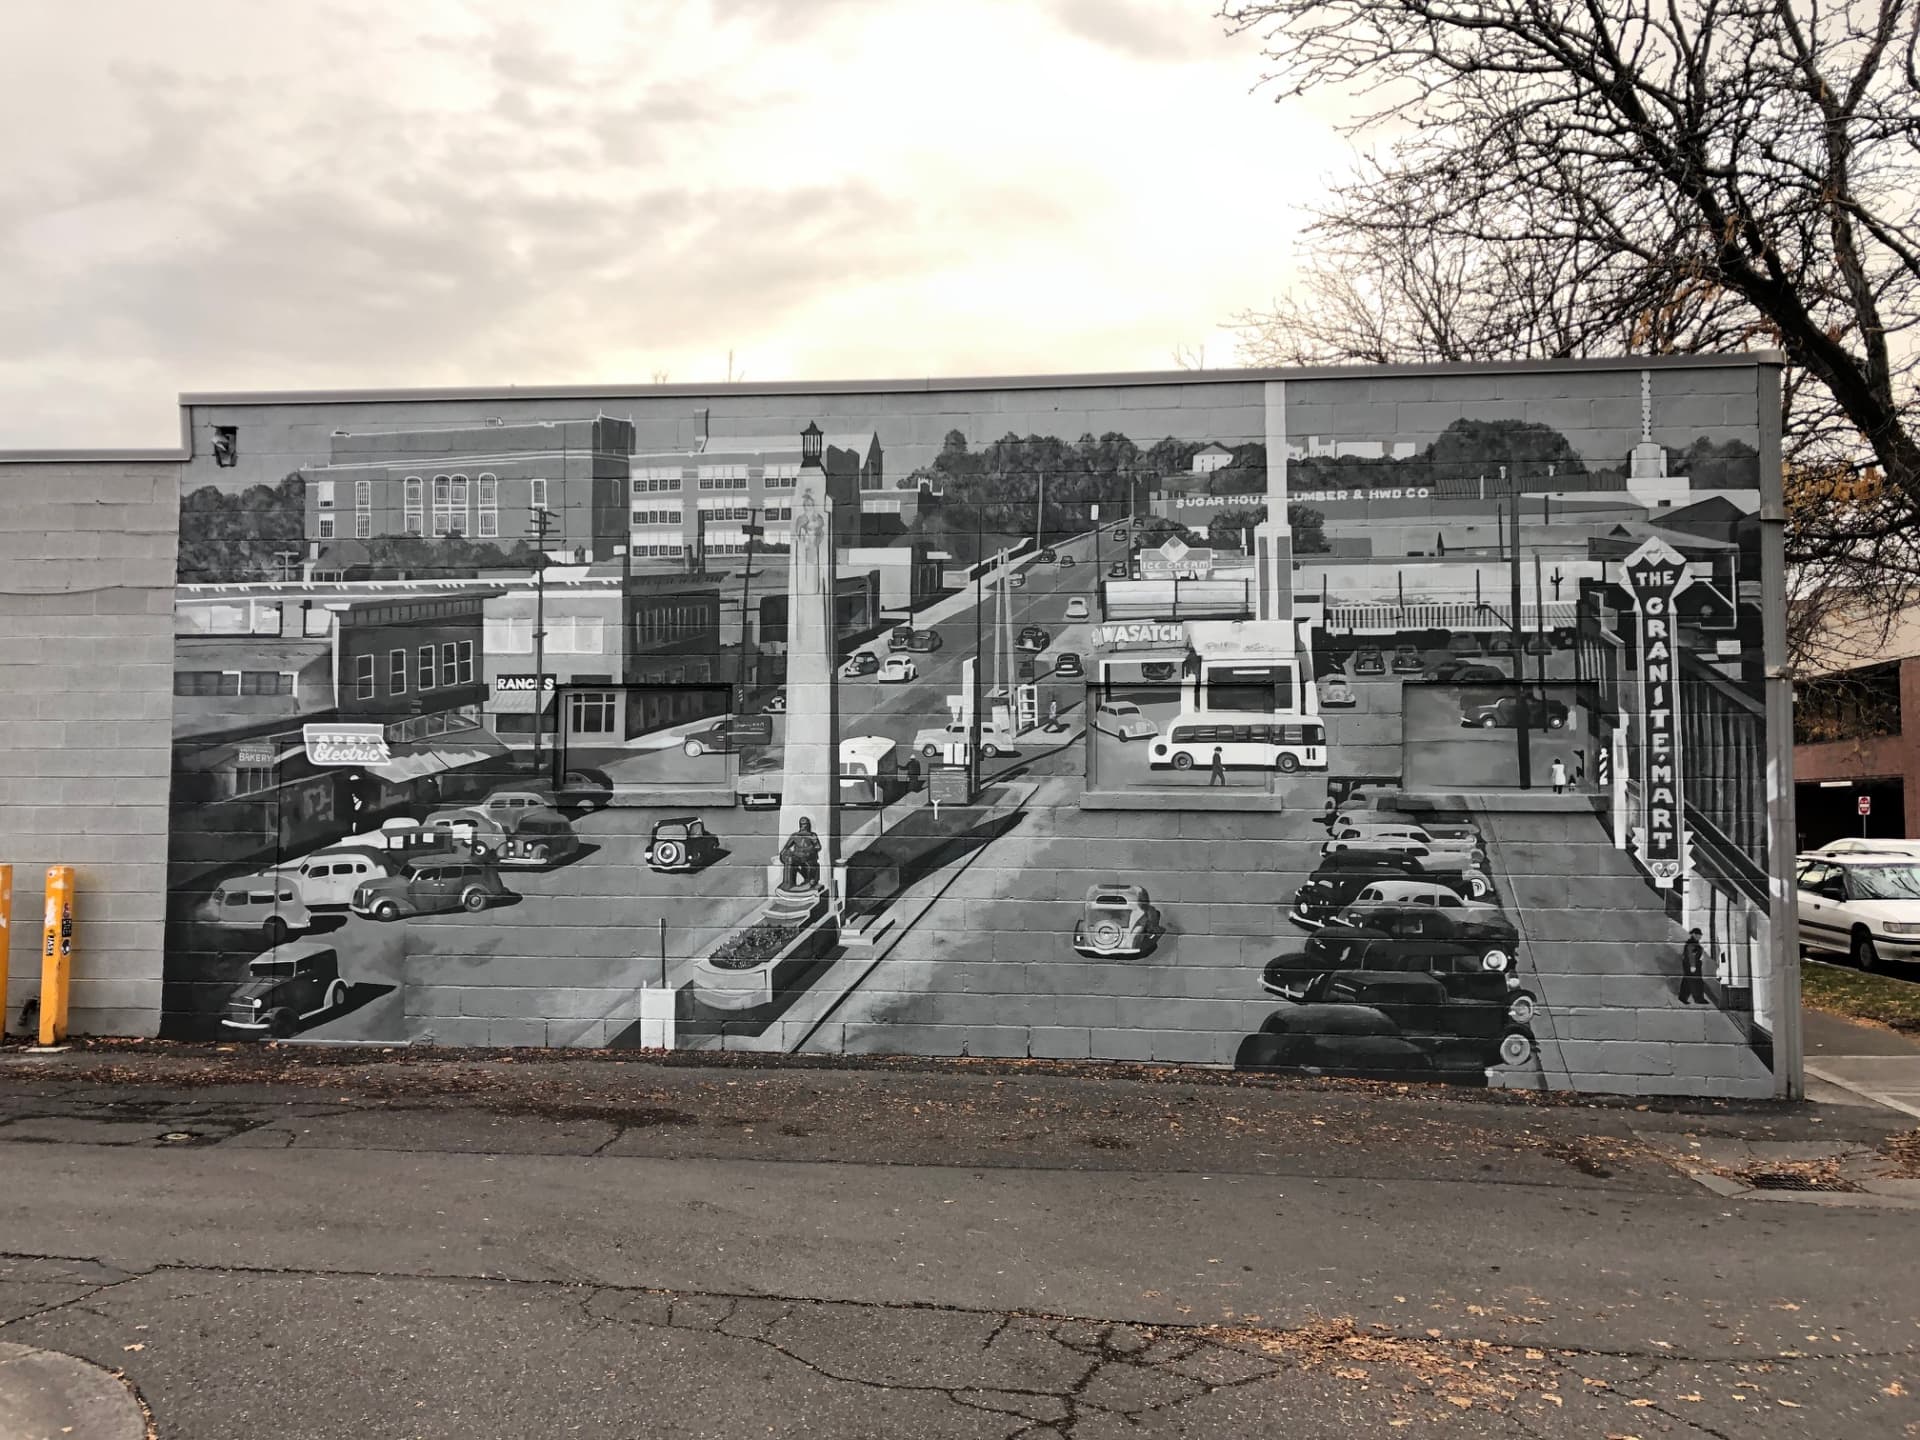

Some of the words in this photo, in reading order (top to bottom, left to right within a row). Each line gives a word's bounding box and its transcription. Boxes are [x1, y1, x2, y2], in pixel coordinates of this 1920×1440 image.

[1176, 497, 1225, 509] SUGAR
[1228, 495, 1269, 505] HOUS
[1287, 490, 1348, 502] UMBER
[1353, 489, 1363, 499] &
[1369, 488, 1401, 499] HWD
[1406, 488, 1429, 498] CO
[1635, 570, 1675, 587] THE
[1102, 625, 1183, 642] WASATCH
[316, 735, 369, 745] APEX
[239, 752, 273, 761] BAKERY
[314, 742, 380, 762] Electric
